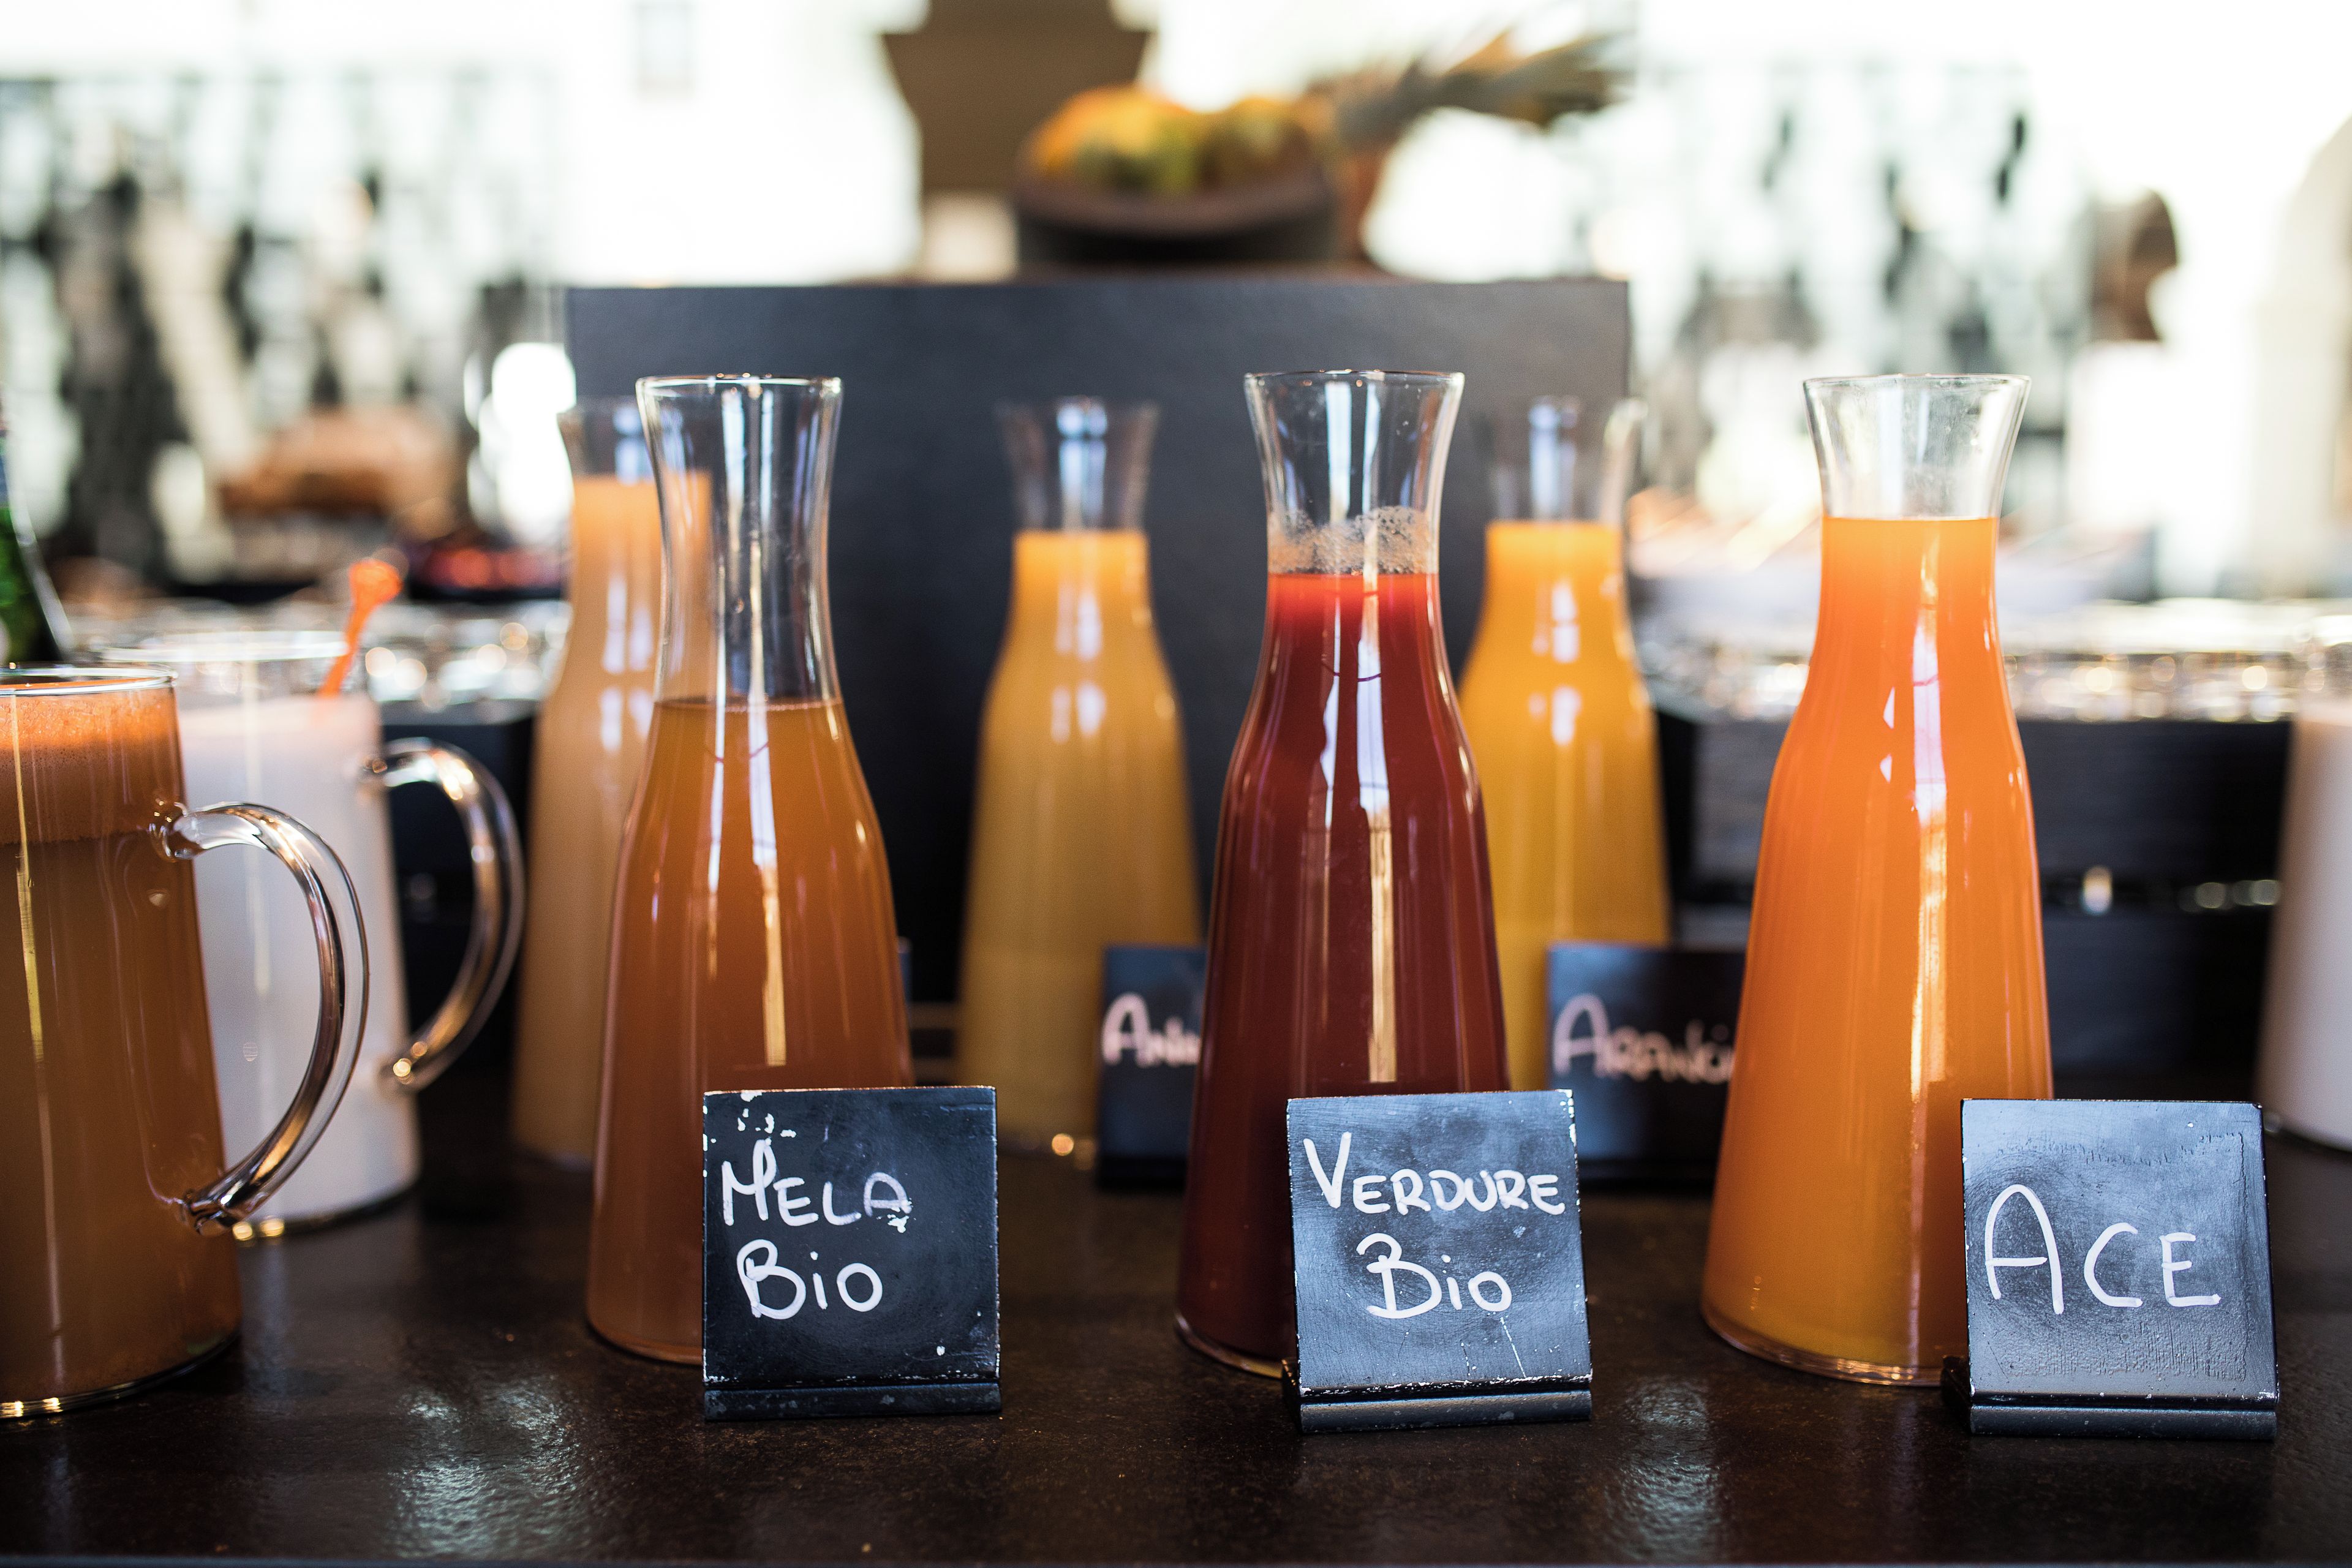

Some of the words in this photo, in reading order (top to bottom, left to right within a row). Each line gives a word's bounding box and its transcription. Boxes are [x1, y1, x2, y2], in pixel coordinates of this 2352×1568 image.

[722, 1139, 912, 1226] MELA
[1303, 1131, 1566, 1215] VERDURE
[1984, 1184, 2222, 1314] ACE
